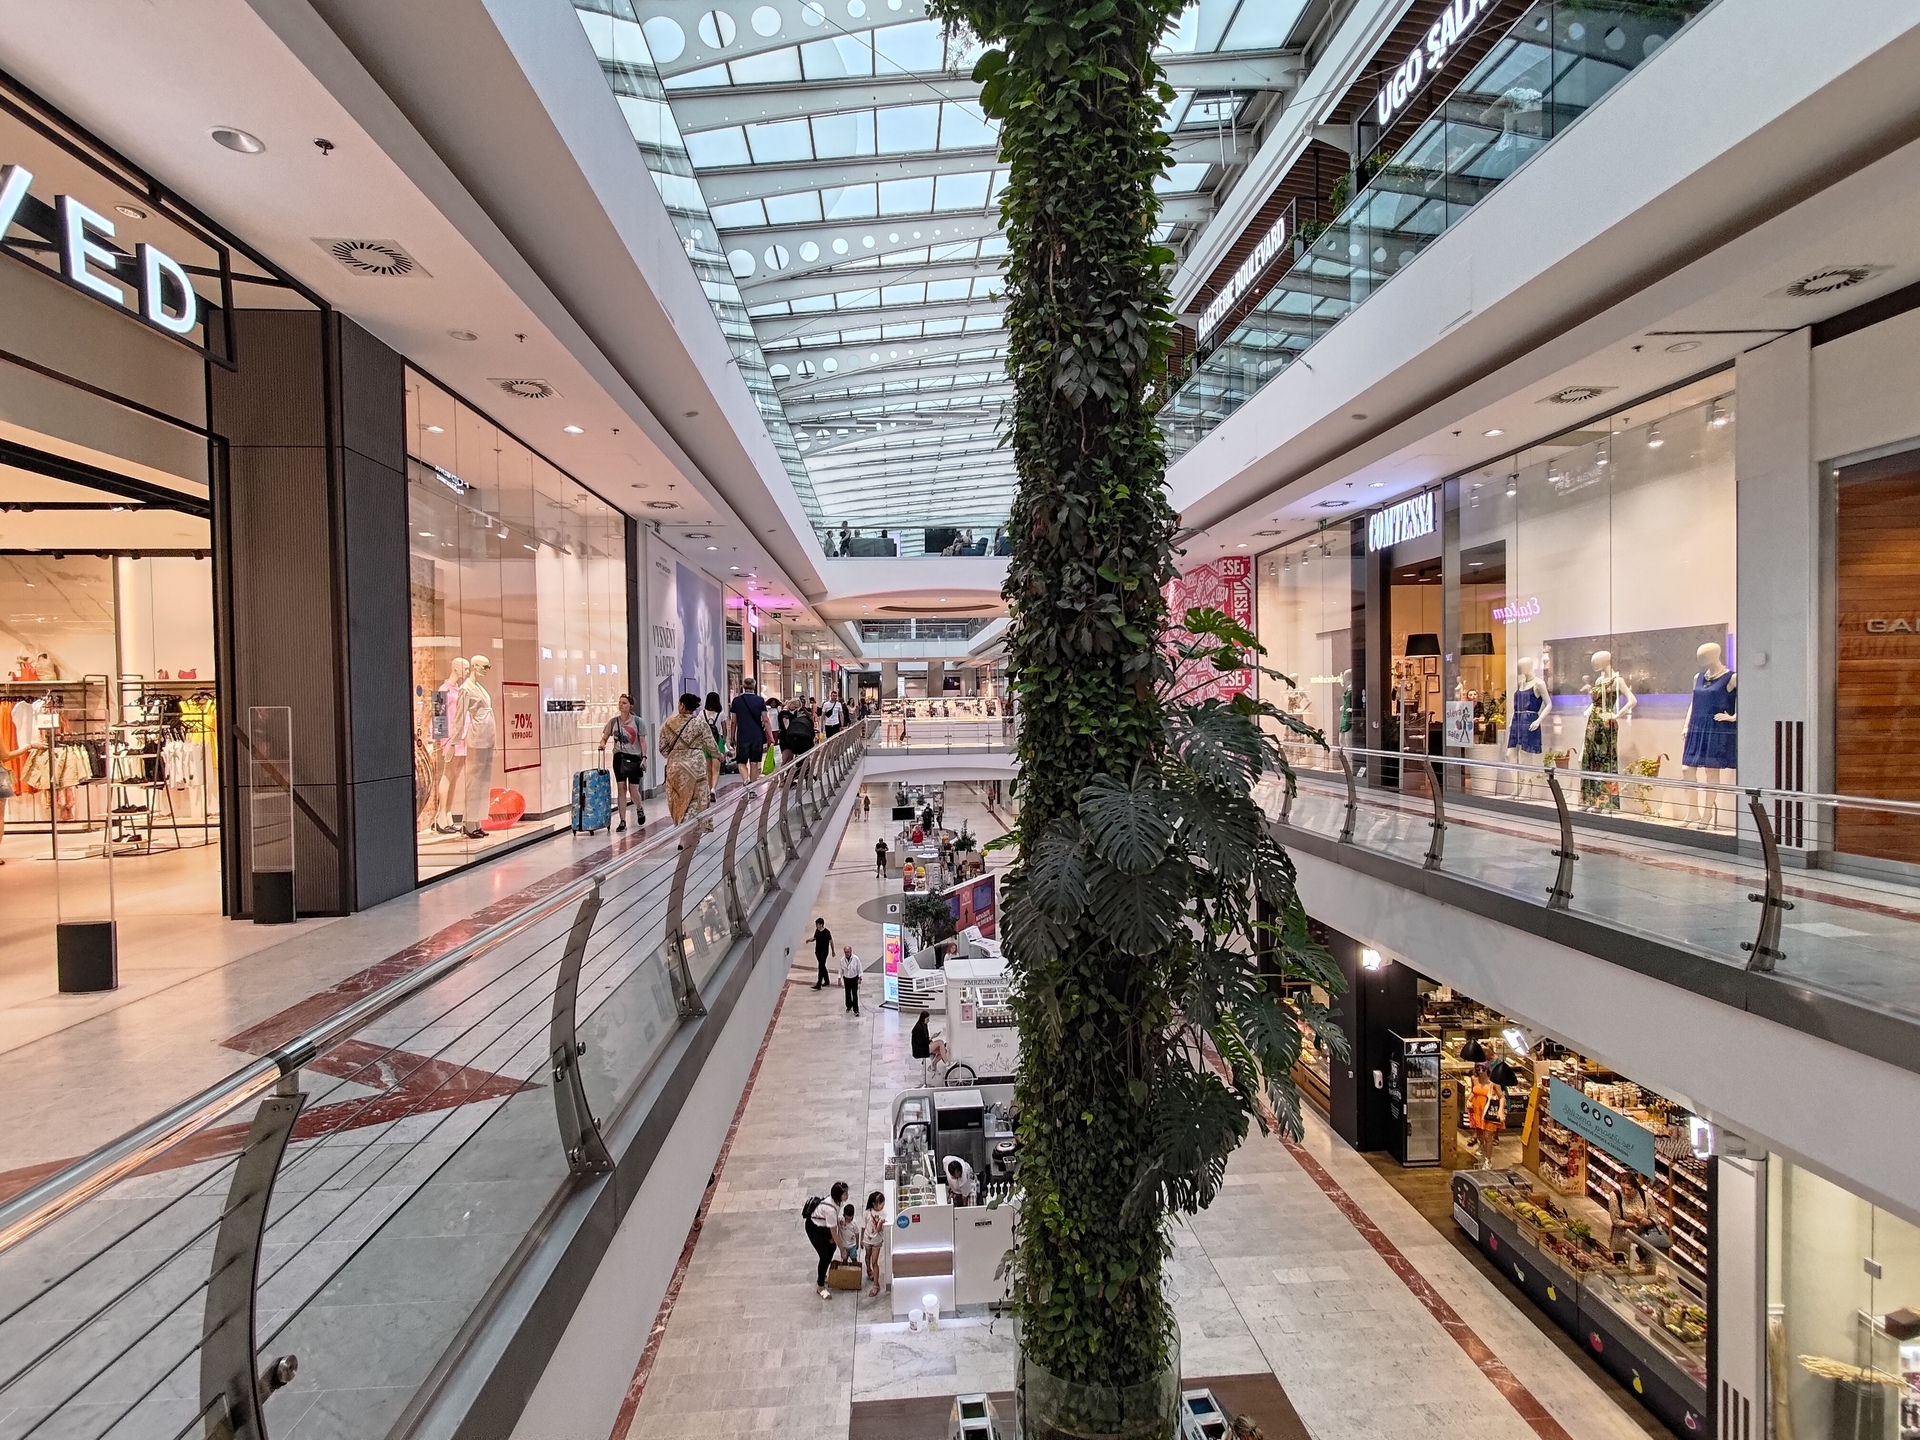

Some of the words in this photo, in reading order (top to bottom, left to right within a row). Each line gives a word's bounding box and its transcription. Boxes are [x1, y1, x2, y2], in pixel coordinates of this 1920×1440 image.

[1378, 48, 1423, 125] UGO
[1198, 277, 1236, 342] BAGETERIE
[1235, 217, 1285, 299] BOULEVARD
[1368, 491, 1434, 552] COMTESSA
[655, 650, 676, 677] DÁREK?
[511, 713, 533, 729] -70%
[1446, 709, 1462, 718] sleva
[511, 730, 533, 740] VÝPRODEJ
[1447, 730, 1460, 740] sale
